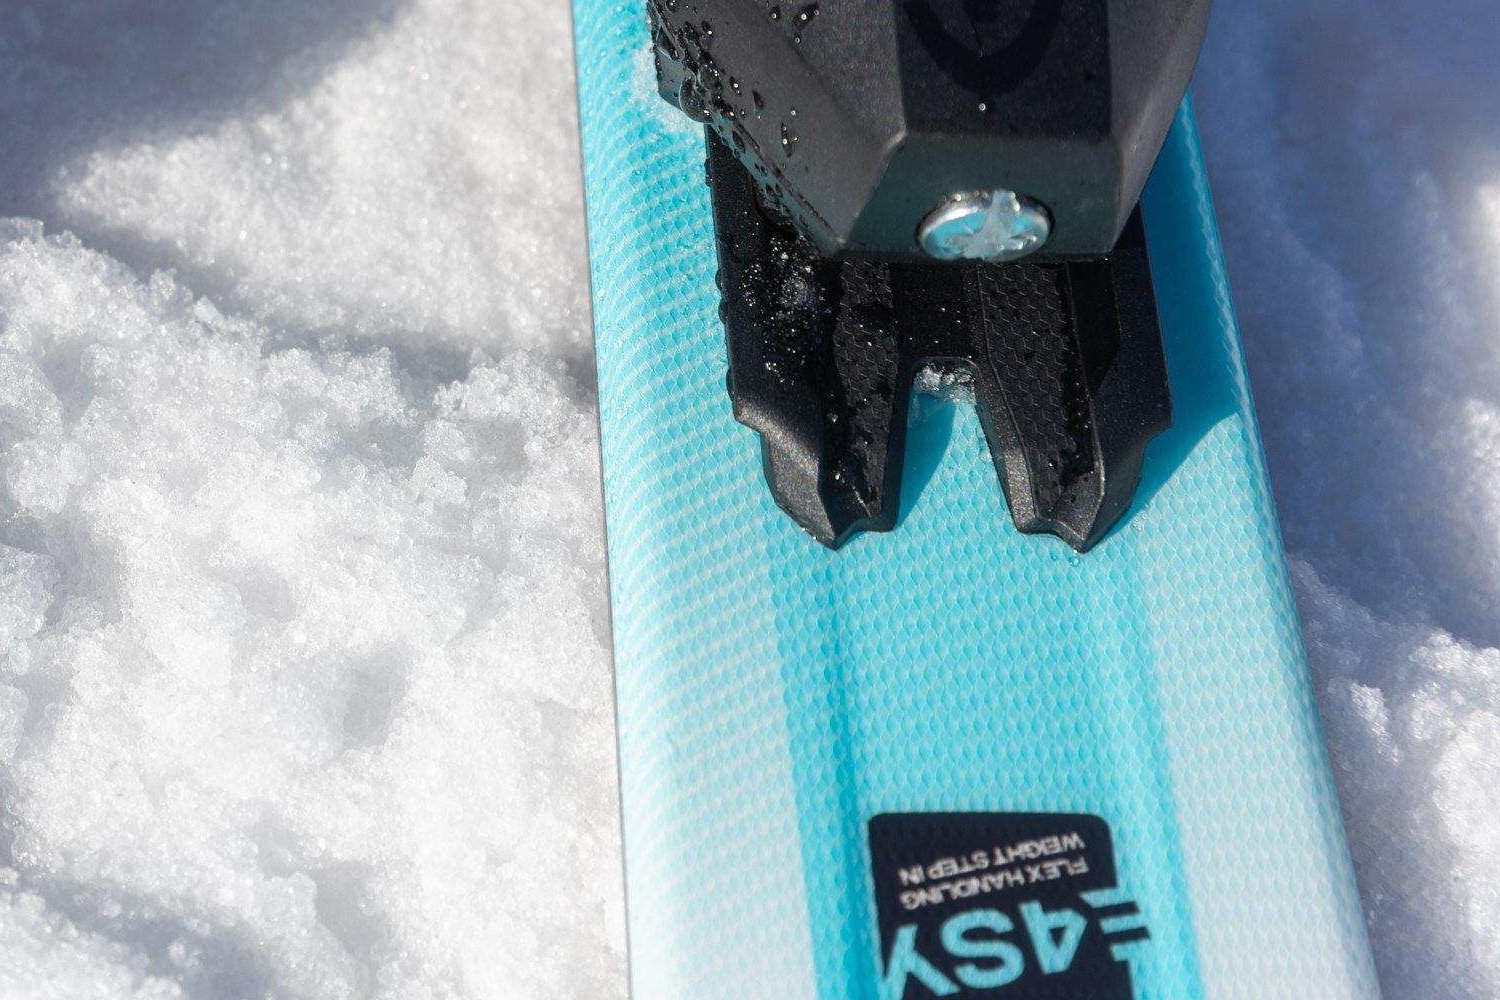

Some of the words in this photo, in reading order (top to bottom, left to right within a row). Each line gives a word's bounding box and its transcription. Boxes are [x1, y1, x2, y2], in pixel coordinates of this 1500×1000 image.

[992, 831, 1086, 866] WEIGHT
[898, 864, 926, 888] IN
[926, 850, 990, 880] STEP
[1026, 855, 1090, 884] FLEX
[899, 871, 1025, 911] HANDLING
